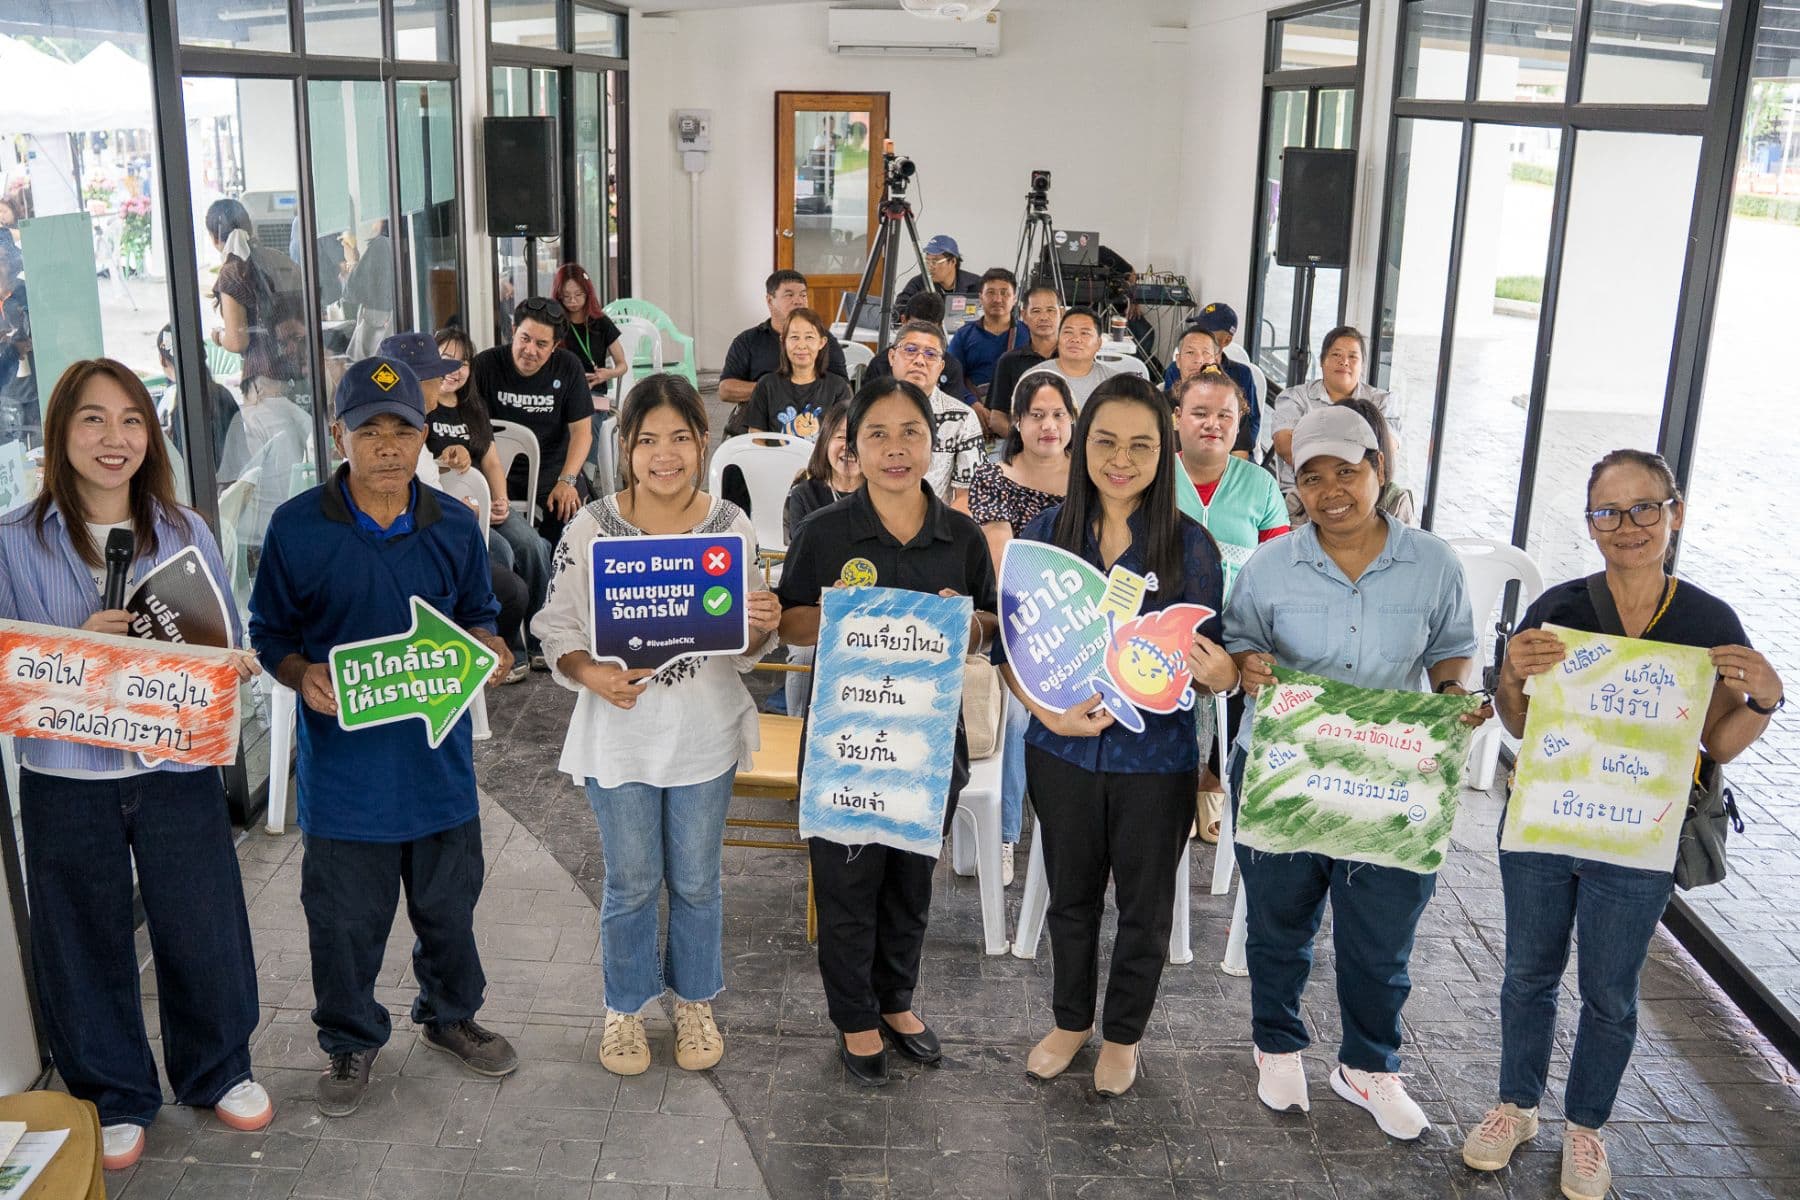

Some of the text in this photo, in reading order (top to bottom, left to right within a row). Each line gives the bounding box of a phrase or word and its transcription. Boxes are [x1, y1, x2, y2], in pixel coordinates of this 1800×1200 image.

[604, 556, 694, 574] Zero Burn
[605, 583, 695, 604] แผนชุมชน
[612, 598, 690, 620] จัดการไฟ
[1008, 568, 1083, 635] เข้าใจ
[342, 644, 459, 686] ป่าใกล้เรา
[1562, 643, 1612, 674] เปลี่ยน
[17, 652, 209, 714] ลดไฟ ลดฝุ่น
[346, 677, 462, 714] ให้เราดูแล
[1624, 662, 1676, 696] แก้ฝุ่น
[1590, 683, 1659, 719] เชิงรับ
[37, 706, 193, 751] ลดผลกระทบ
[1543, 733, 1570, 757] เป็น
[1268, 747, 1297, 770] เป็น
[1602, 754, 1649, 784] แก้ฝุ่น
[1553, 790, 1642, 825] เชิงระบบ
